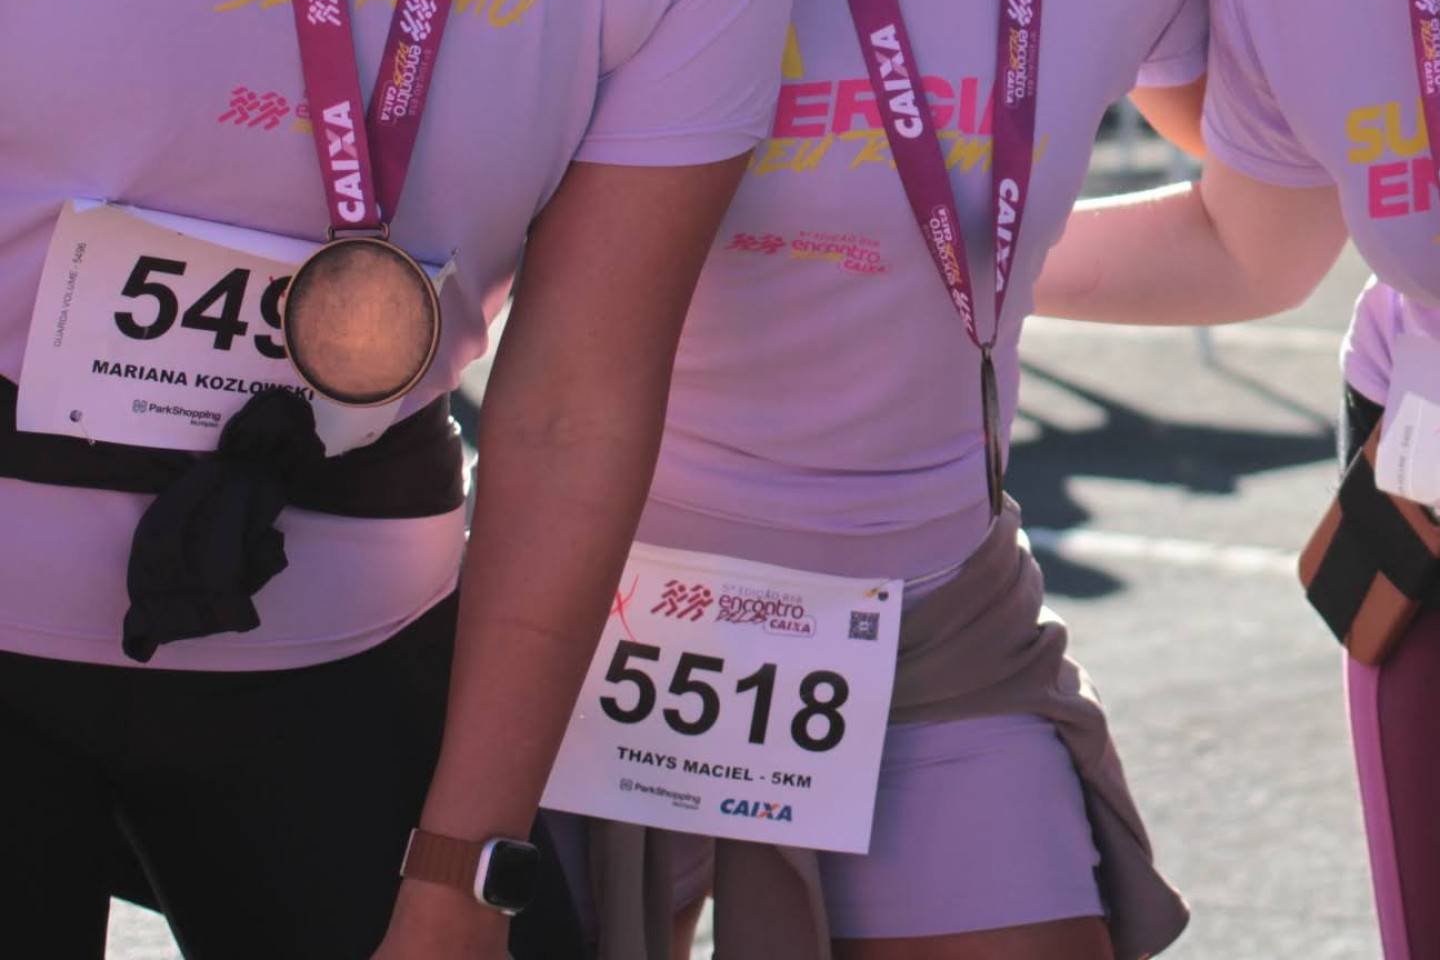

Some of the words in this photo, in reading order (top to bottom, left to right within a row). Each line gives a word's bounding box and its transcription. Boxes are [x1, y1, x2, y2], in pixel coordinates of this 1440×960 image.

[870, 24, 924, 139] CAIXA
[323, 101, 366, 222] CAIXA
[92, 359, 187, 386] MARIANA
[149, 402, 221, 422] ParkShopping
[718, 595, 804, 620] encontro
[769, 618, 811, 633] CAIXA
[600, 640, 850, 753] 5518
[617, 746, 677, 770] THAYS
[683, 759, 754, 782] MACIEL
[771, 771, 812, 789] 5KM
[719, 798, 793, 823] CAIXA
